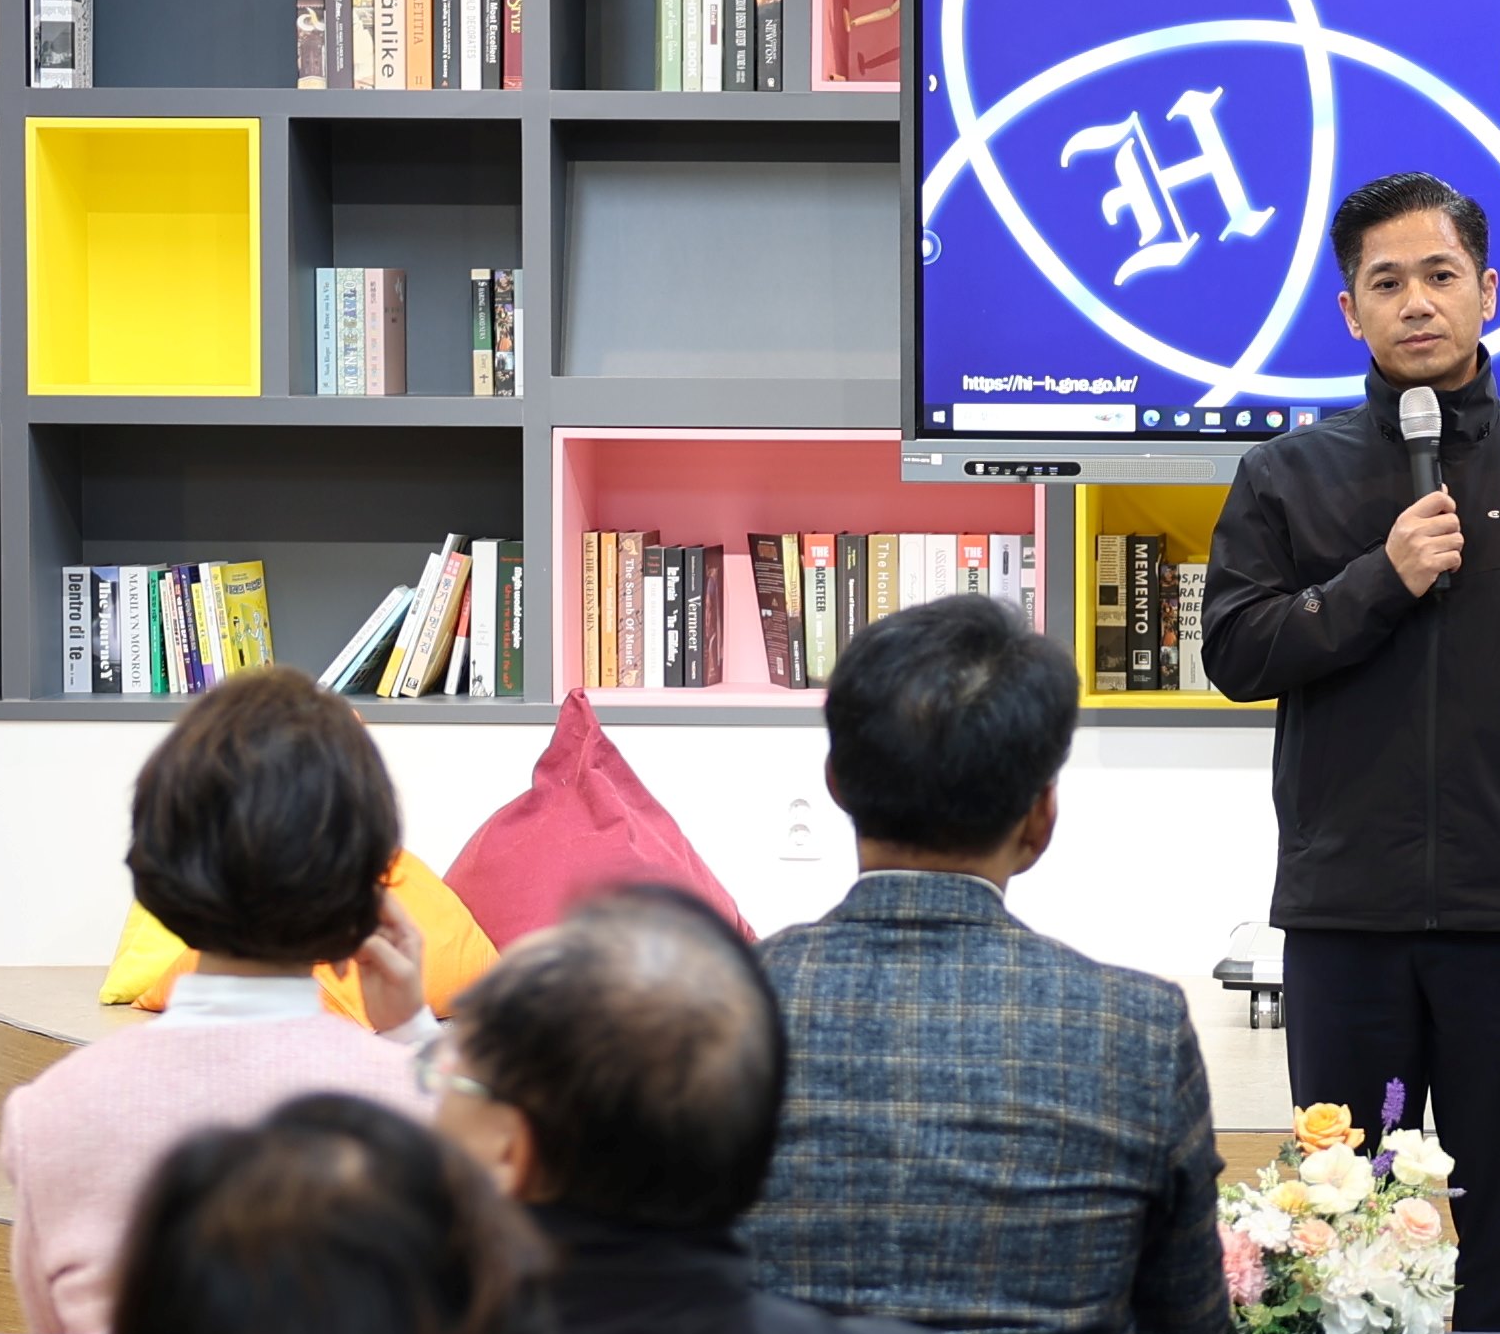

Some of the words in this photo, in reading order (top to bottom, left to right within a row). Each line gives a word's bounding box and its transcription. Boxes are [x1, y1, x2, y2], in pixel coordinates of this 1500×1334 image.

[764, 19, 774, 65] NEWTON
[625, 558, 636, 579] The
[810, 546, 829, 558] THE
[877, 542, 890, 568] The
[963, 546, 983, 558] THE
[68, 573, 85, 621] Dentro
[128, 572, 142, 630] MARILYN
[877, 571, 890, 610] Hotel
[1134, 543, 1149, 635] MEMENTO
[68, 625, 85, 639] di
[625, 617, 636, 631] Of
[687, 594, 702, 652] Vermeer
[68, 645, 84, 661] te
[129, 633, 142, 688] MONROE
[625, 633, 636, 666] Music
